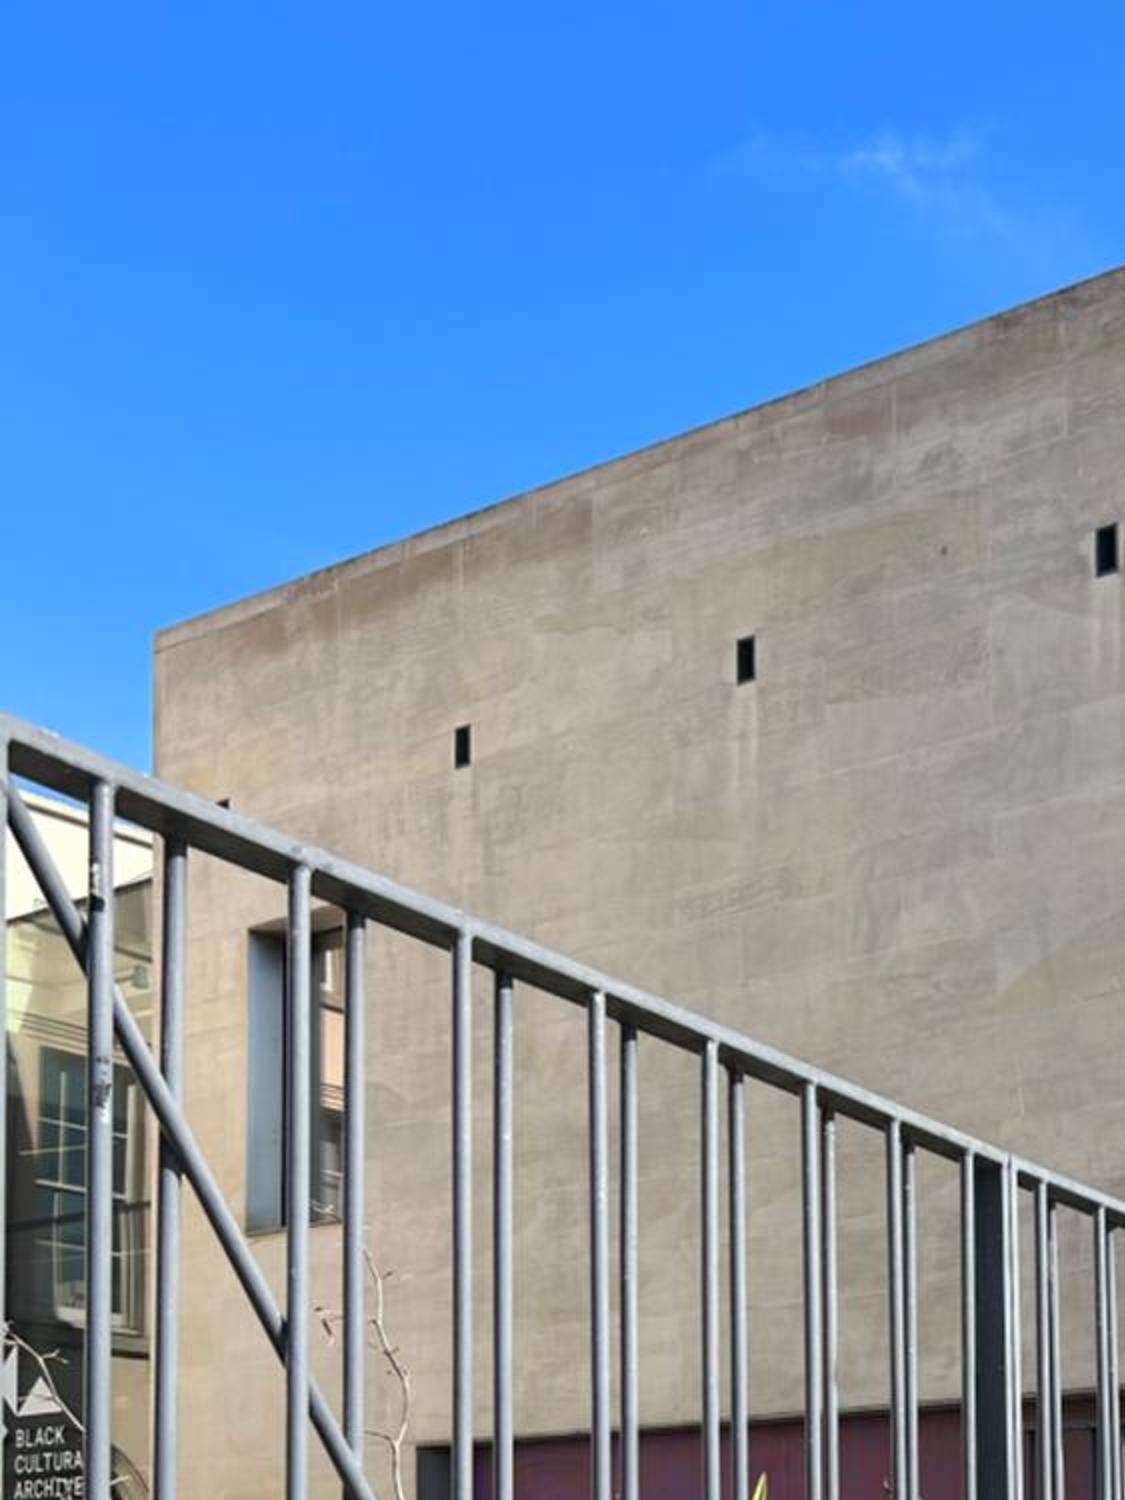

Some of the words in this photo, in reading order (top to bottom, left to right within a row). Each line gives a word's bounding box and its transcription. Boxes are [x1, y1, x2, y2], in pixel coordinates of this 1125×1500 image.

[15, 1424, 65, 1448] BLACK
[14, 1450, 84, 1475] CULTURA
[13, 1476, 85, 1500] ARCHIVE
